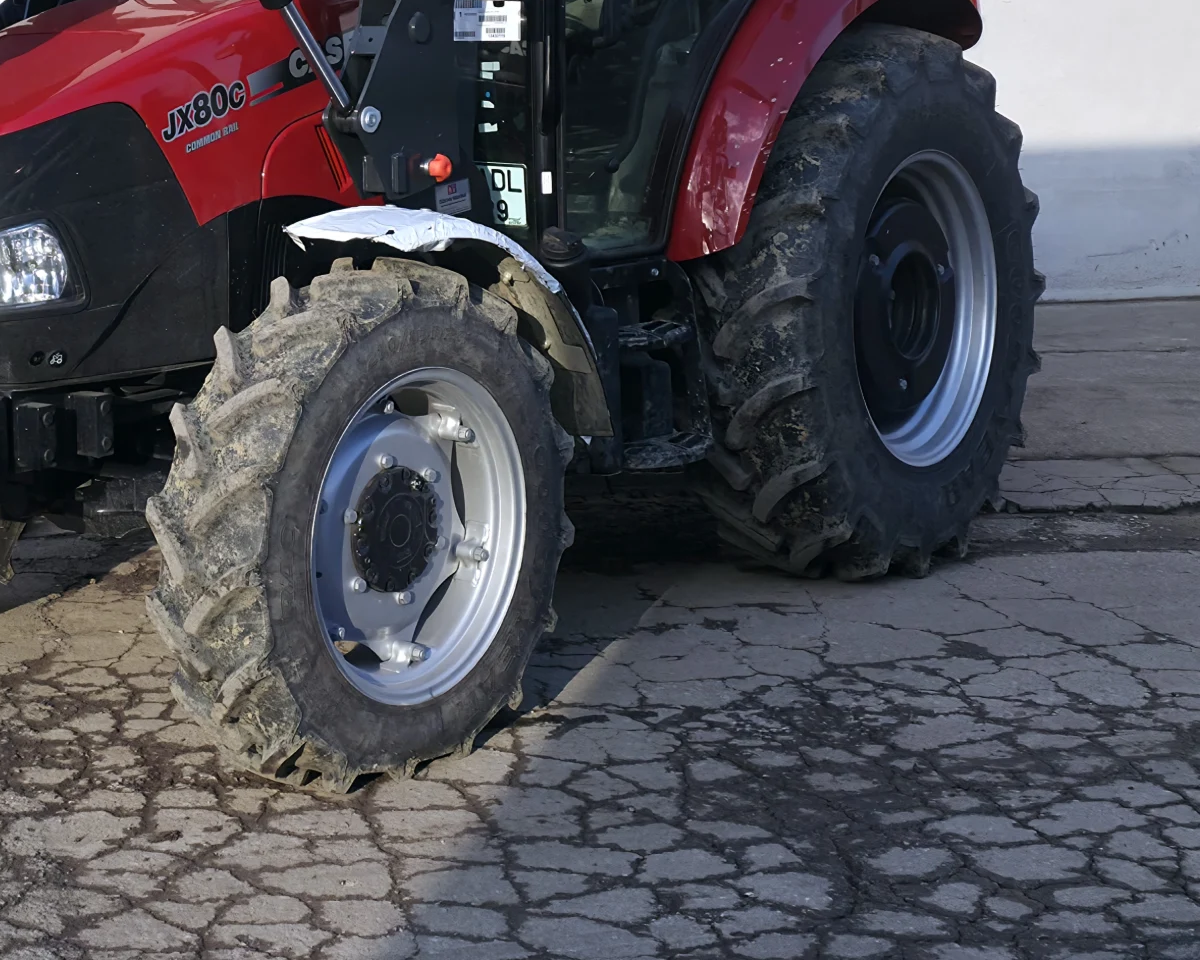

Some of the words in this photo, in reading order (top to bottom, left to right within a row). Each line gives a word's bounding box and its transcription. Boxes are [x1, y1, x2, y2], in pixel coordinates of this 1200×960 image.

[162, 80, 246, 143] JX80C
[186, 129, 222, 154] COMMON
[222, 121, 239, 137] RAIL
